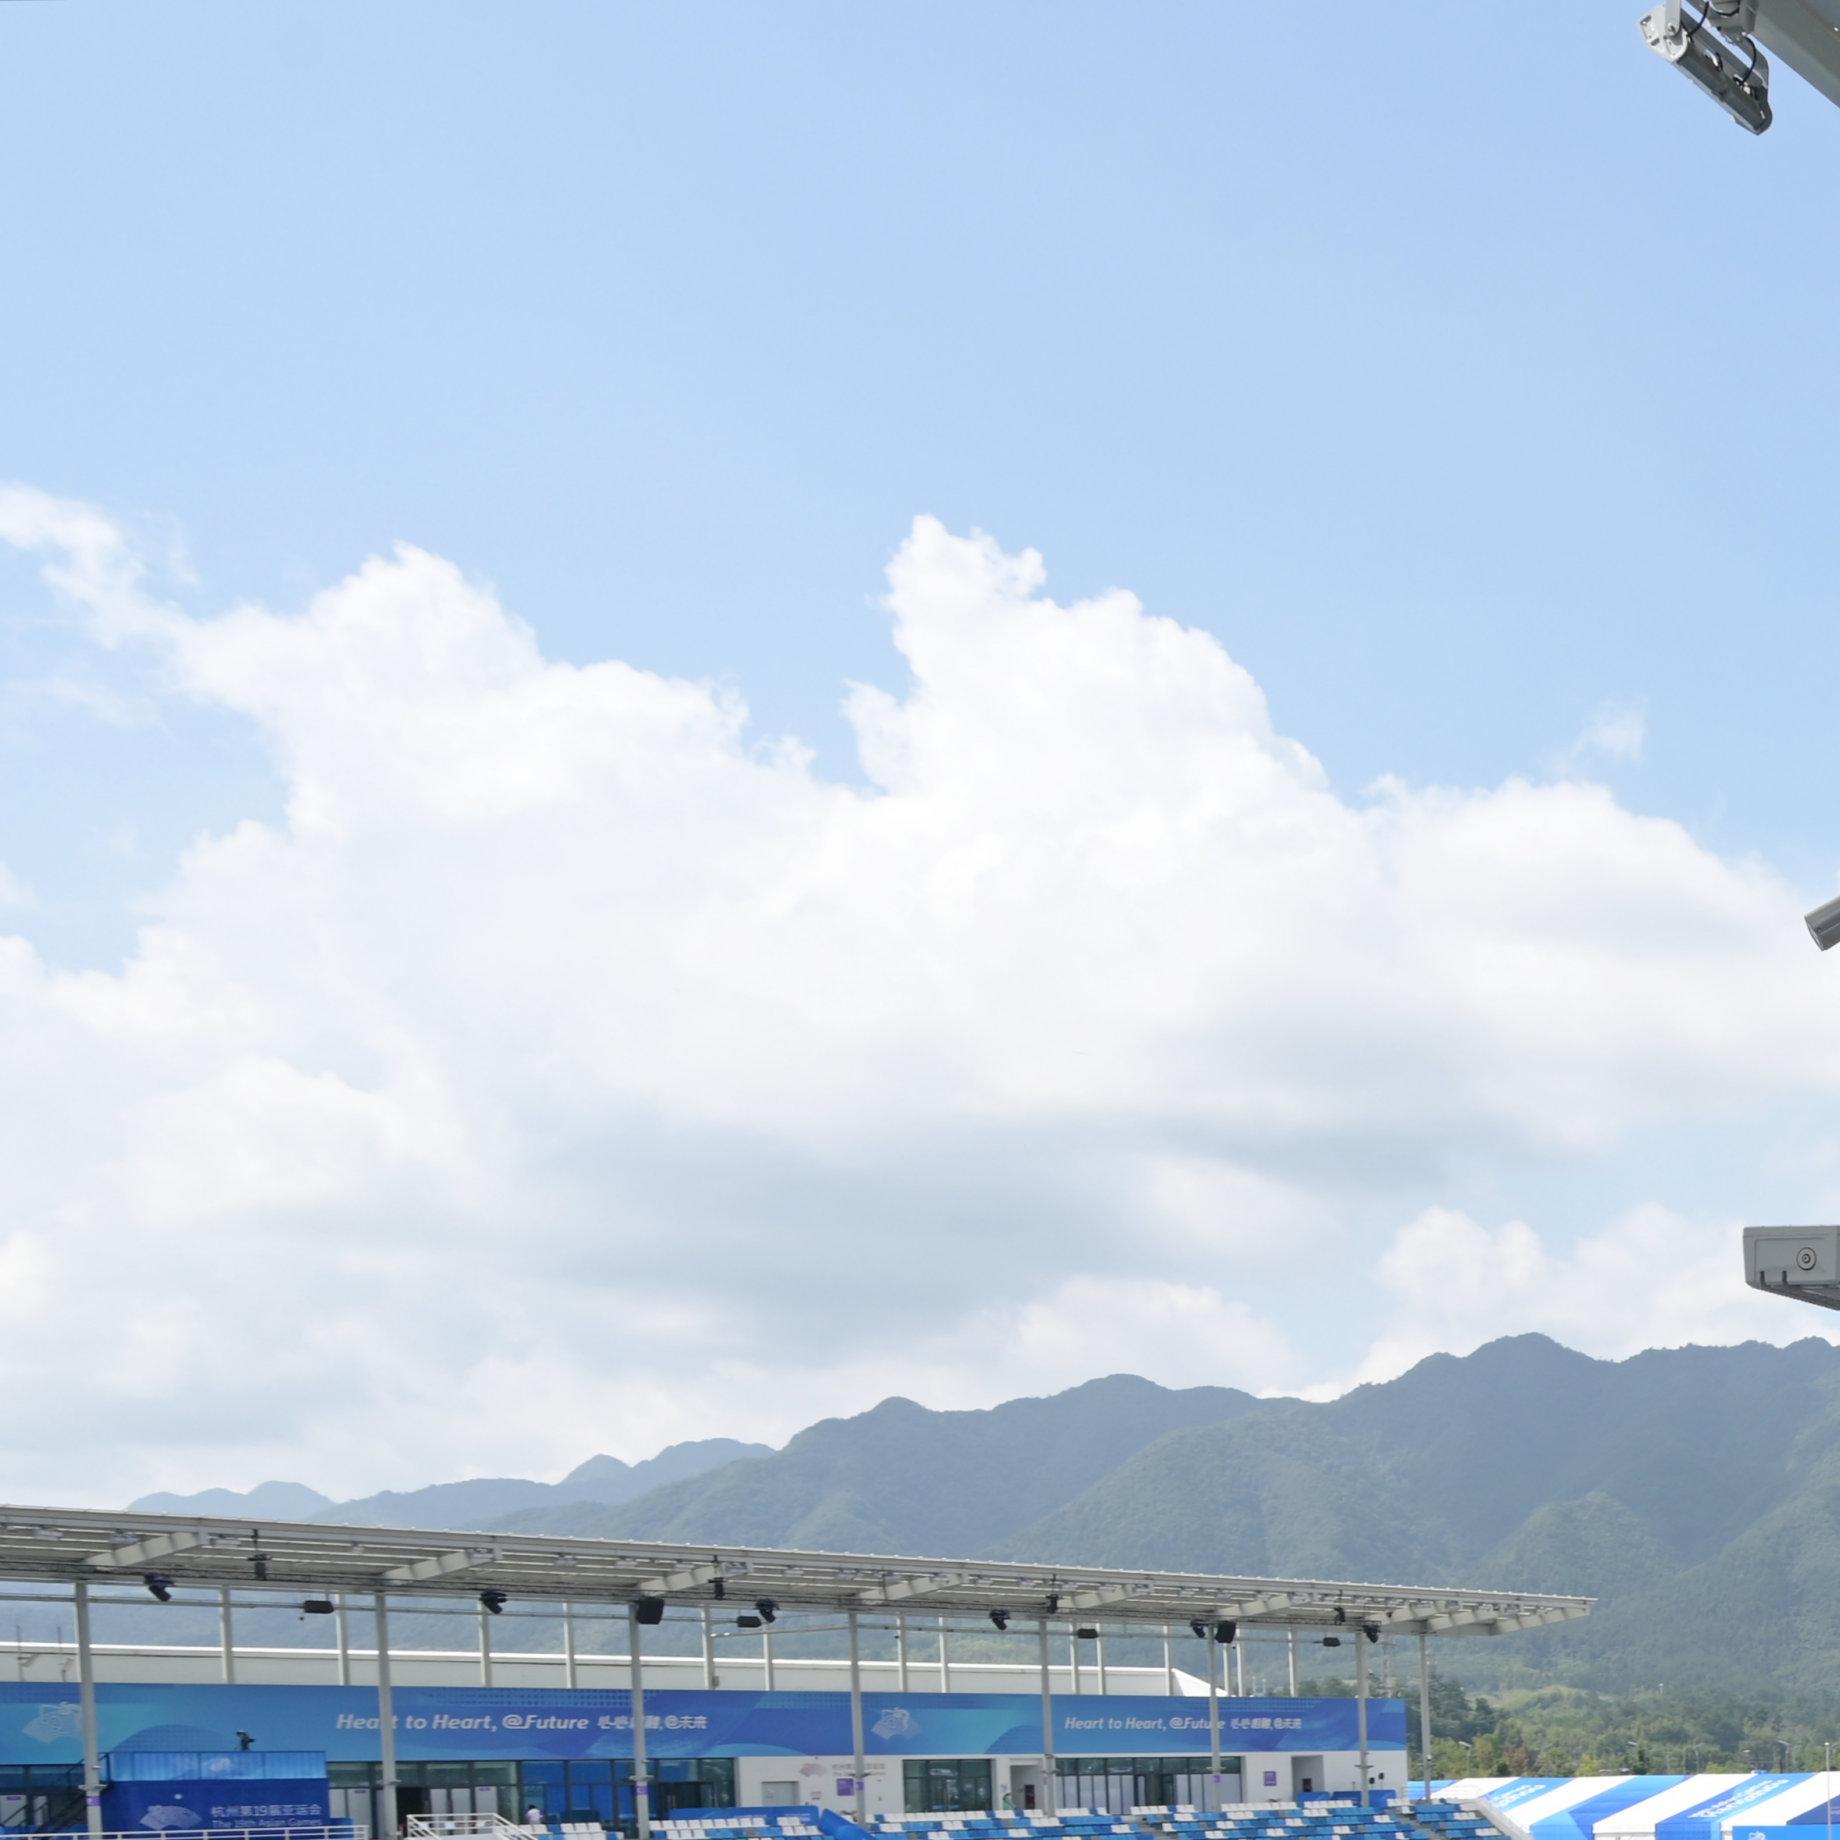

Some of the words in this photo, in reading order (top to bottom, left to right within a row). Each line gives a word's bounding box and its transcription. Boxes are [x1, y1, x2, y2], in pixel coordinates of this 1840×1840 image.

[336, 1714, 398, 1731] Heat
[405, 1715, 427, 1730] to
[432, 1714, 498, 1732] Heart,
[502, 1714, 589, 1731] @Future
[1064, 1716, 1104, 1730] Heart
[1108, 1717, 1121, 1730] to
[1125, 1716, 1167, 1732] Heart,
[1169, 1717, 1226, 1731] @Futue
